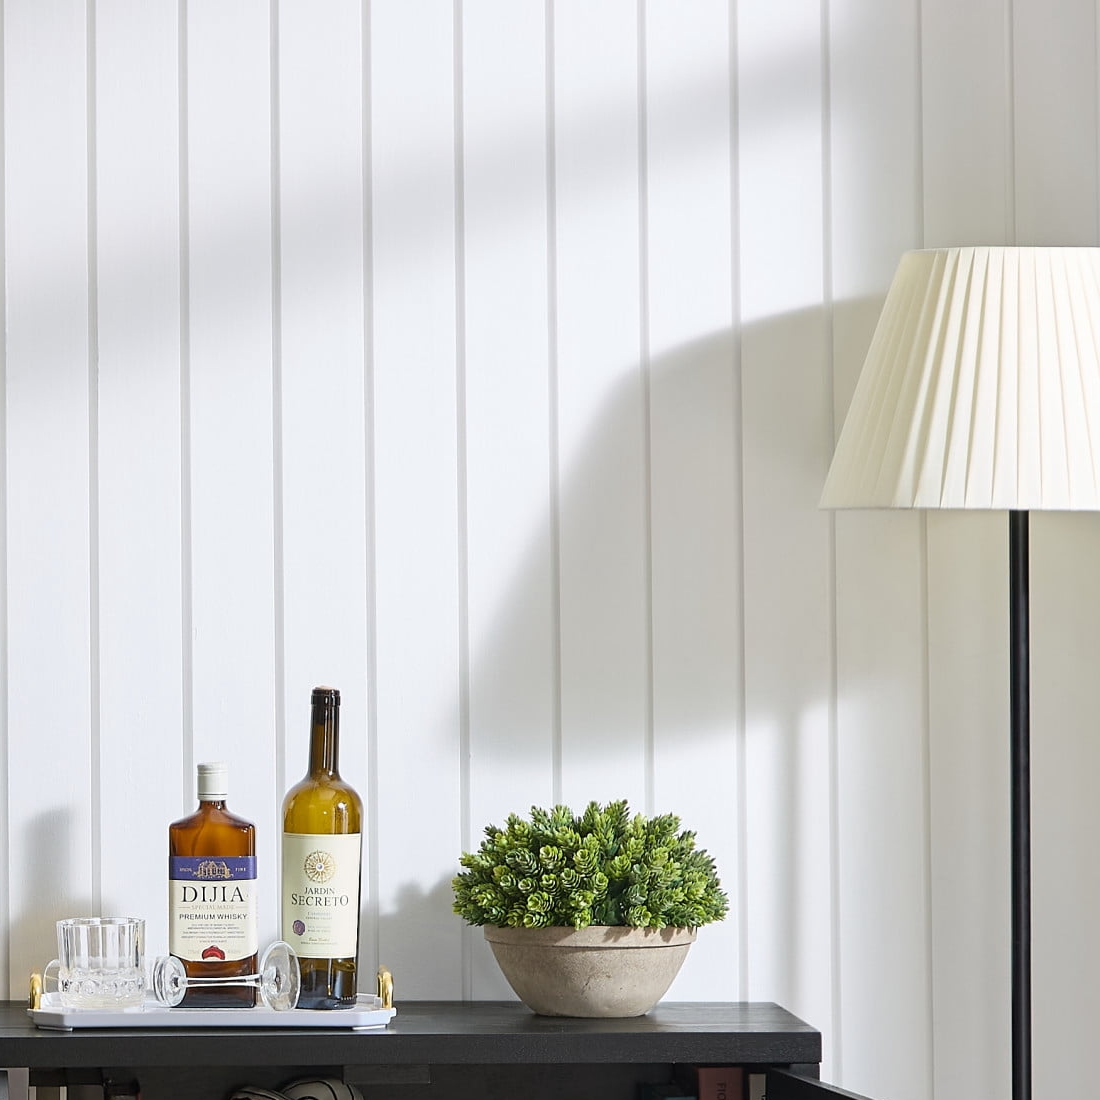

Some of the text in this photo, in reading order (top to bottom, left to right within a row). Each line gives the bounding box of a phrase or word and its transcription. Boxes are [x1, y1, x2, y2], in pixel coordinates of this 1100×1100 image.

[181, 885, 245, 902] DIJIA
[304, 887, 335, 895] JARDIN
[291, 893, 349, 906] SECRETO
